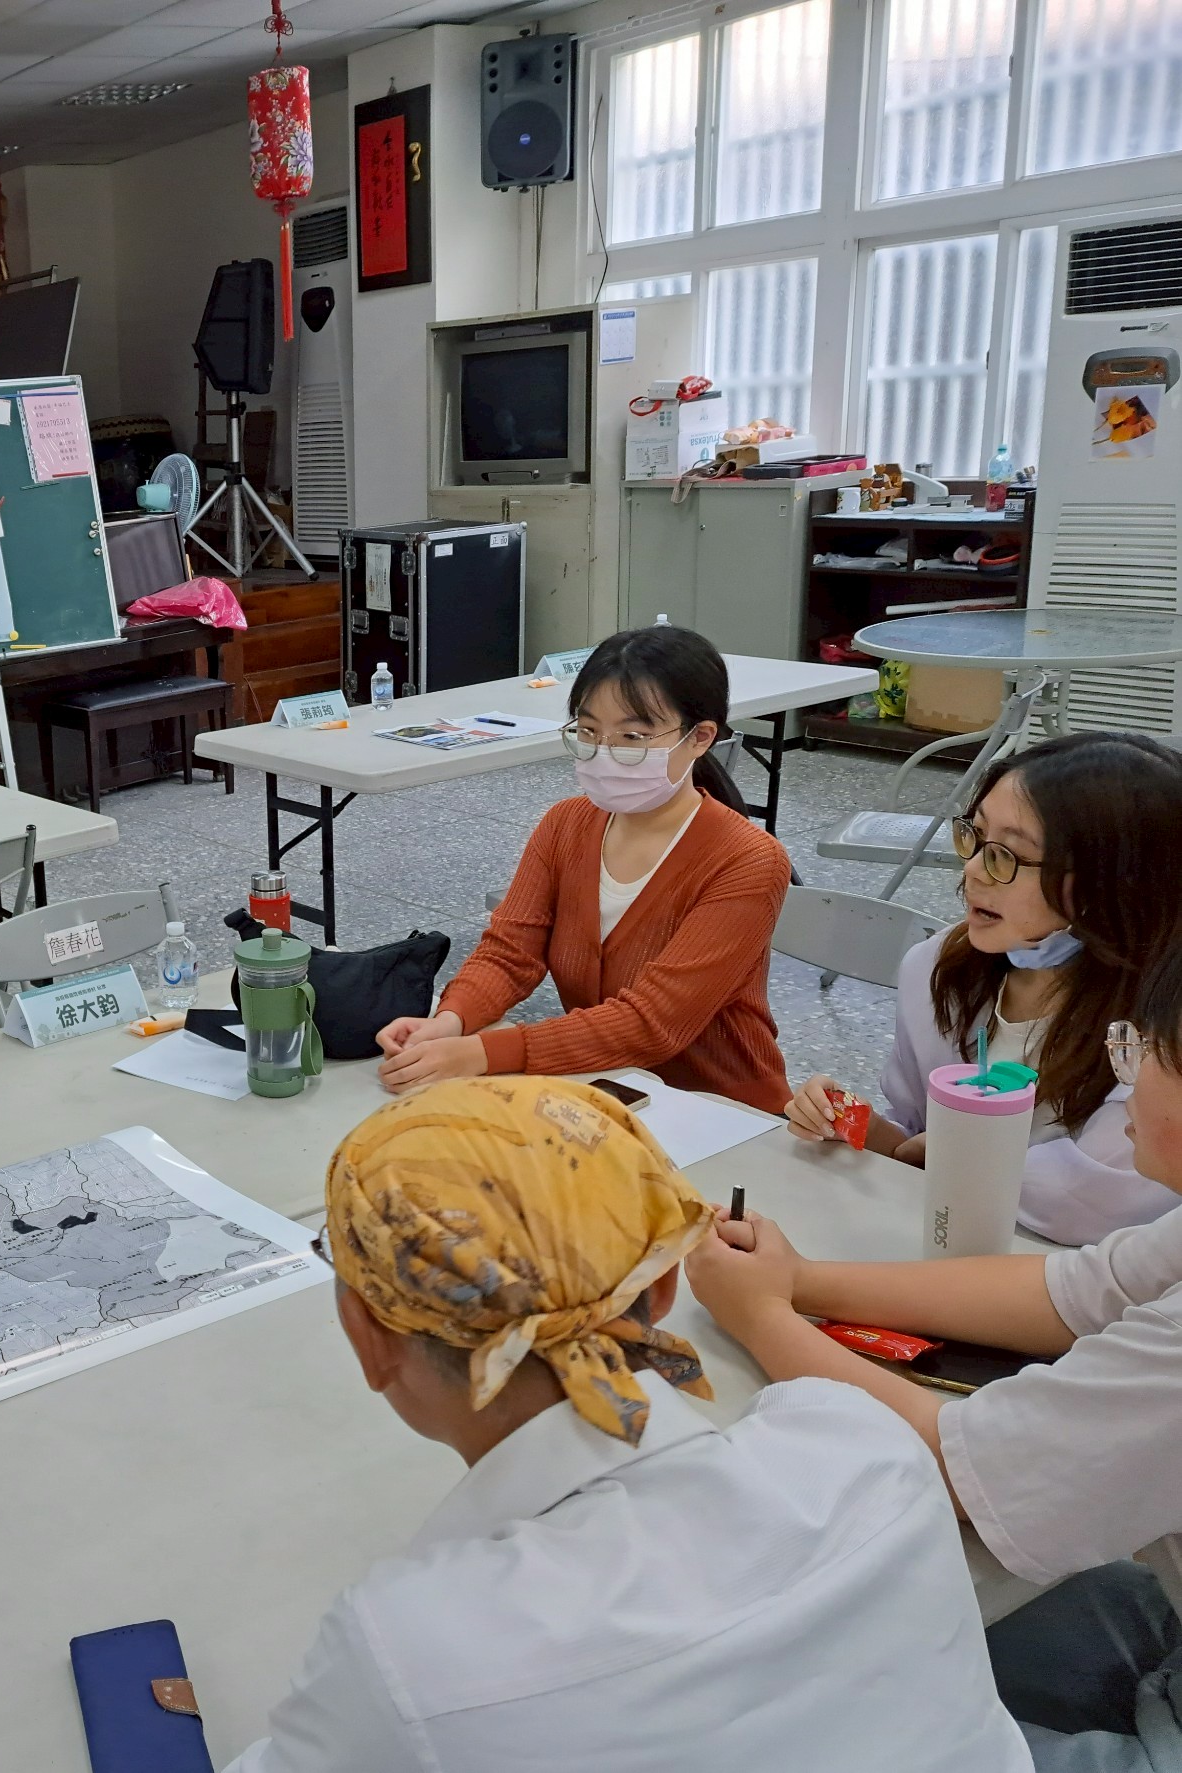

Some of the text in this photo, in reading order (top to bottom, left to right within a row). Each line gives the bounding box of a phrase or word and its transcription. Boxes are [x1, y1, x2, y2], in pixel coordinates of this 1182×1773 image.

[562, 660, 585, 674] 陳玄
[47, 926, 102, 960] 詹春花
